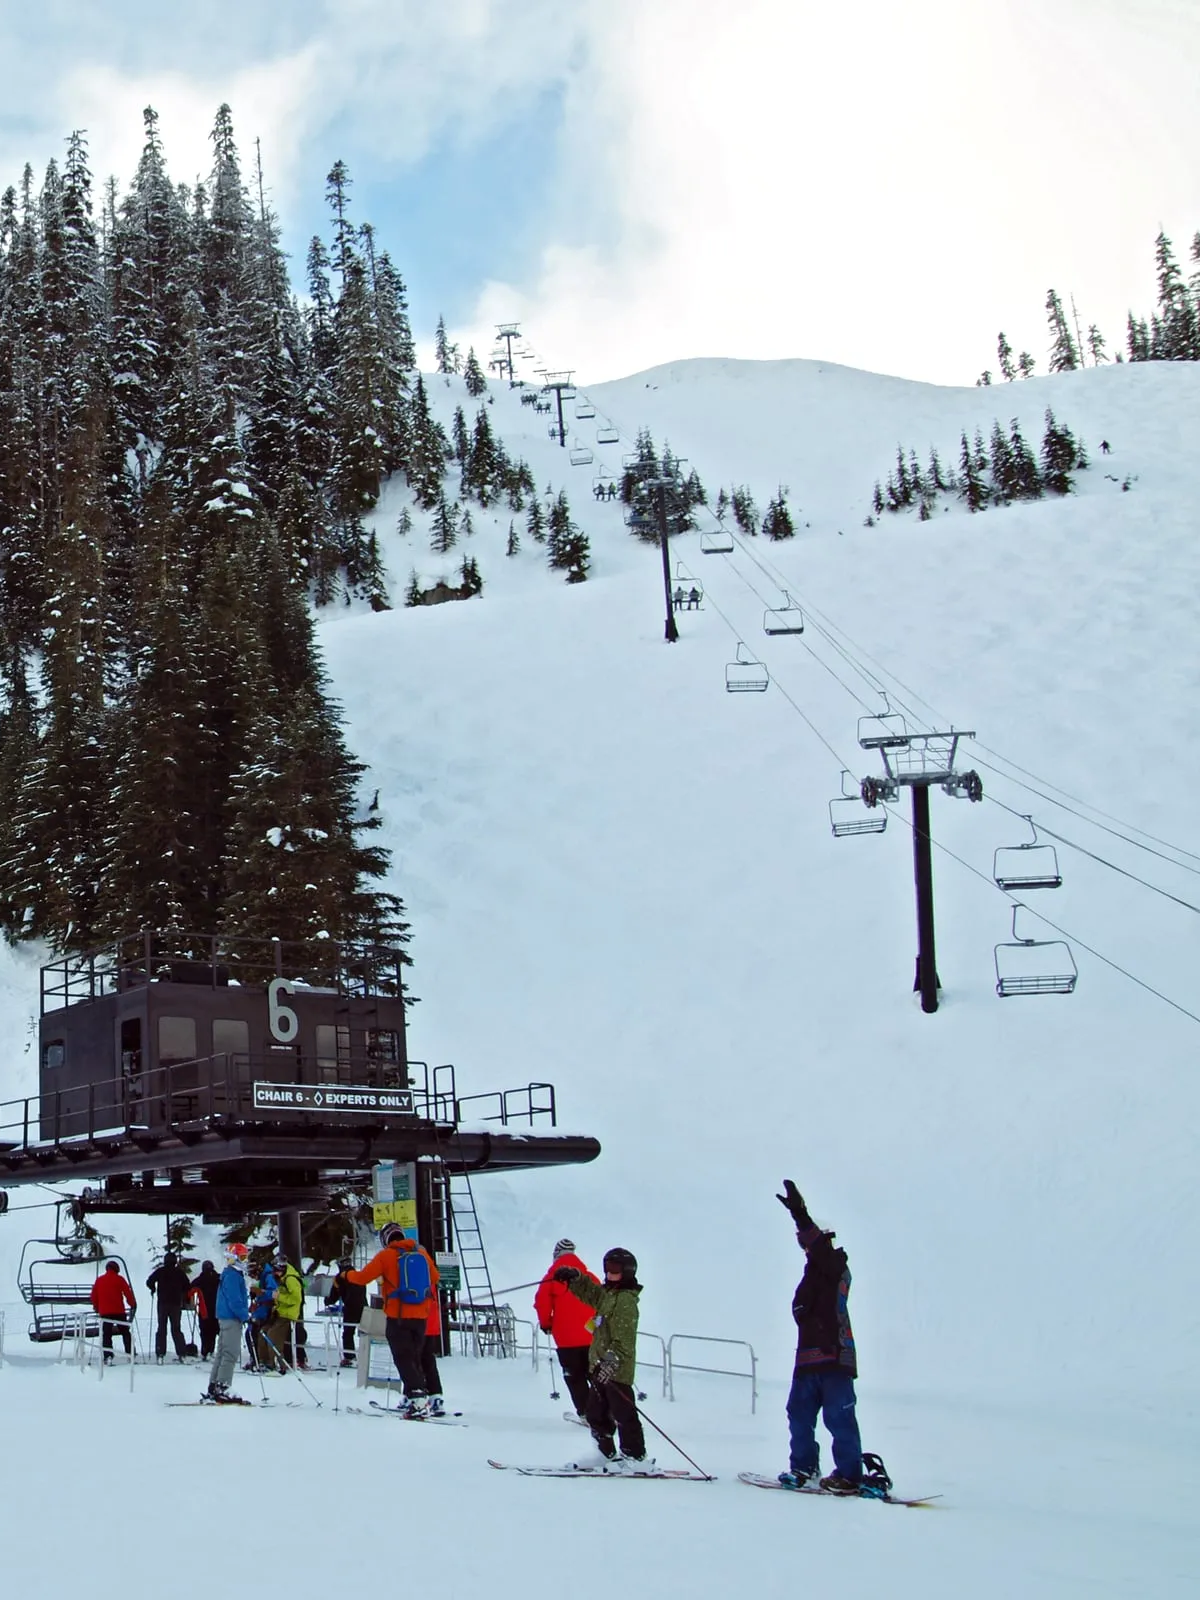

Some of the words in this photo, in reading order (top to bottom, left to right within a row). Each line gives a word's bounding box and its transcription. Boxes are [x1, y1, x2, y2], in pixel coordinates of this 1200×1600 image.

[268, 977, 298, 1042] 6
[257, 1090, 293, 1102] CHAIR
[296, 1092, 304, 1102] 6
[325, 1093, 376, 1106] EXPERTS
[378, 1096, 409, 1106] ONLY
